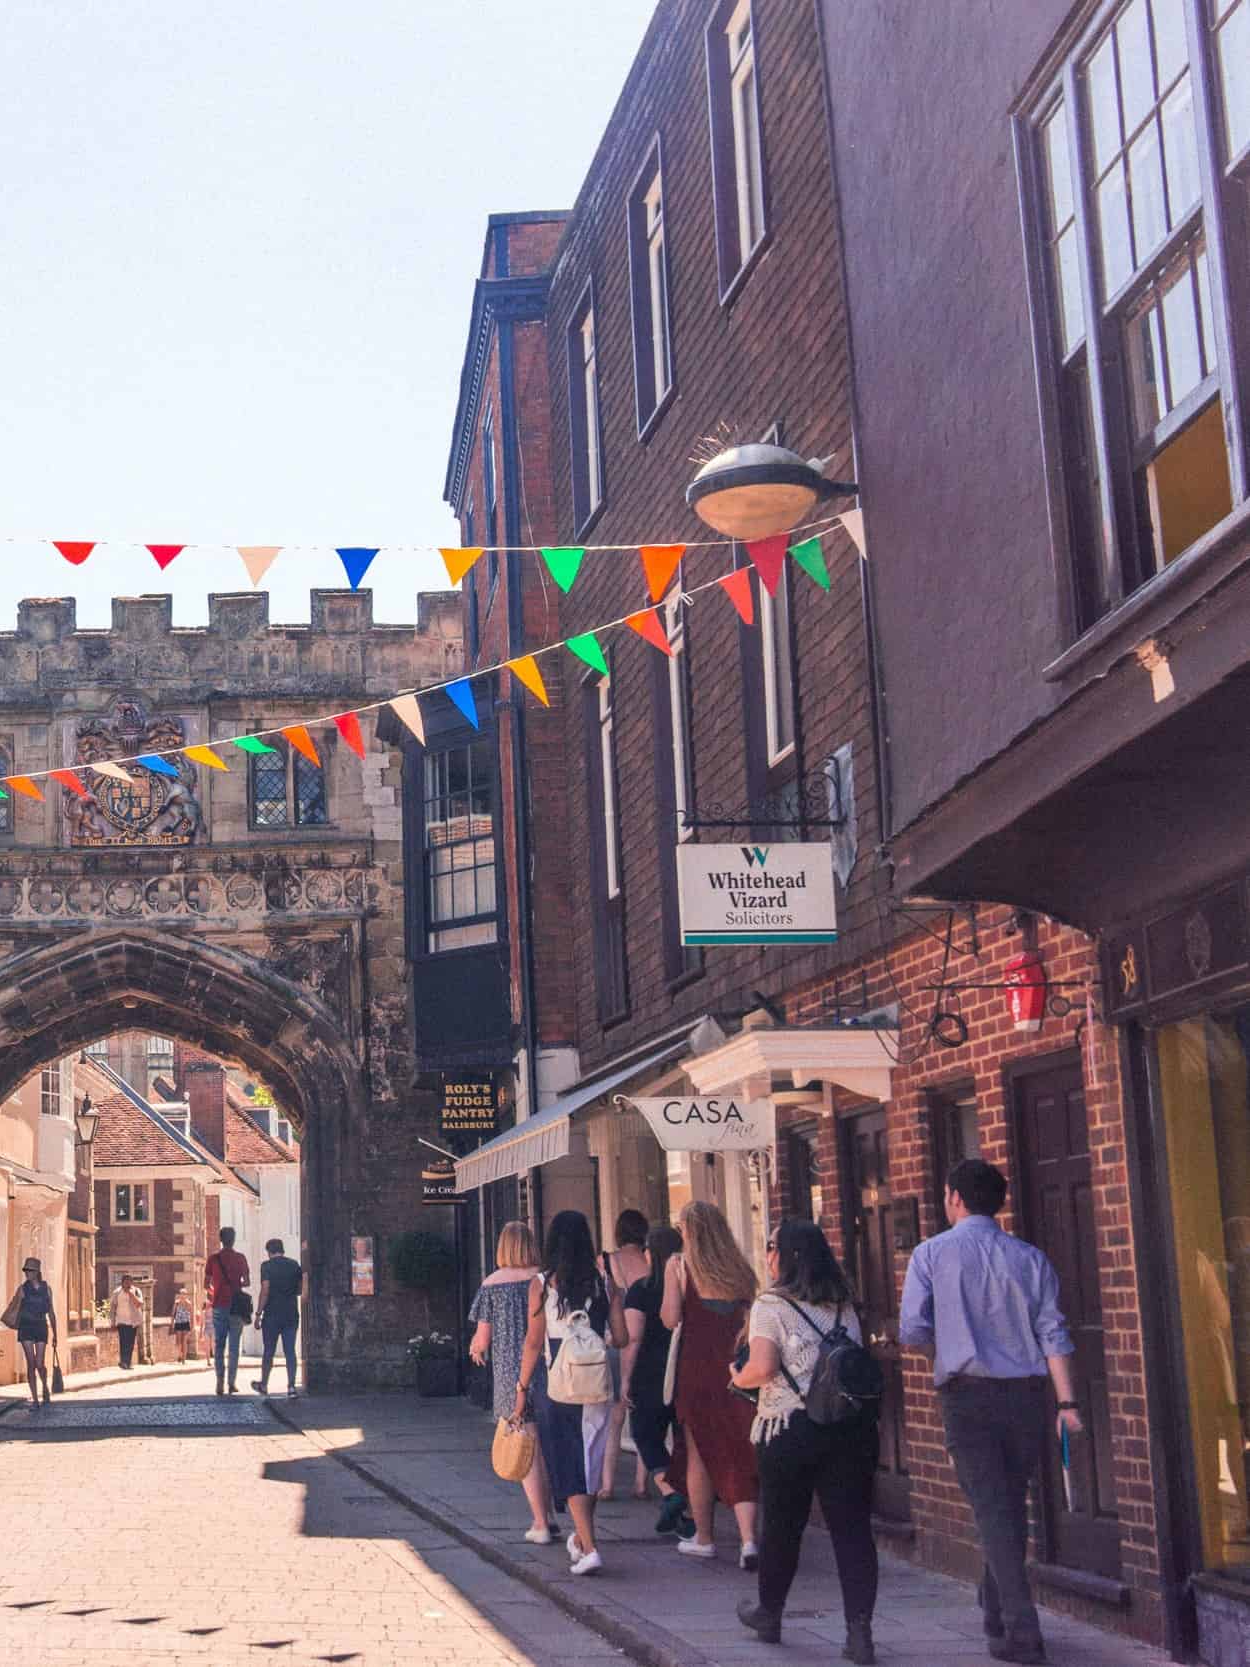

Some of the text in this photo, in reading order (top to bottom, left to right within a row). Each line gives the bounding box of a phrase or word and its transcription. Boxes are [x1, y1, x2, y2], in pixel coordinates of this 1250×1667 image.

[707, 871, 807, 889] Whitehead
[729, 890, 788, 908] Vizard
[725, 911, 794, 926] Solicitors
[445, 1084, 491, 1094] ROLY'S
[445, 1096, 492, 1106] FUDGE
[442, 1108, 495, 1118] PANTRY
[663, 1100, 744, 1125] CASA
[442, 1121, 495, 1129] SALISBURY
